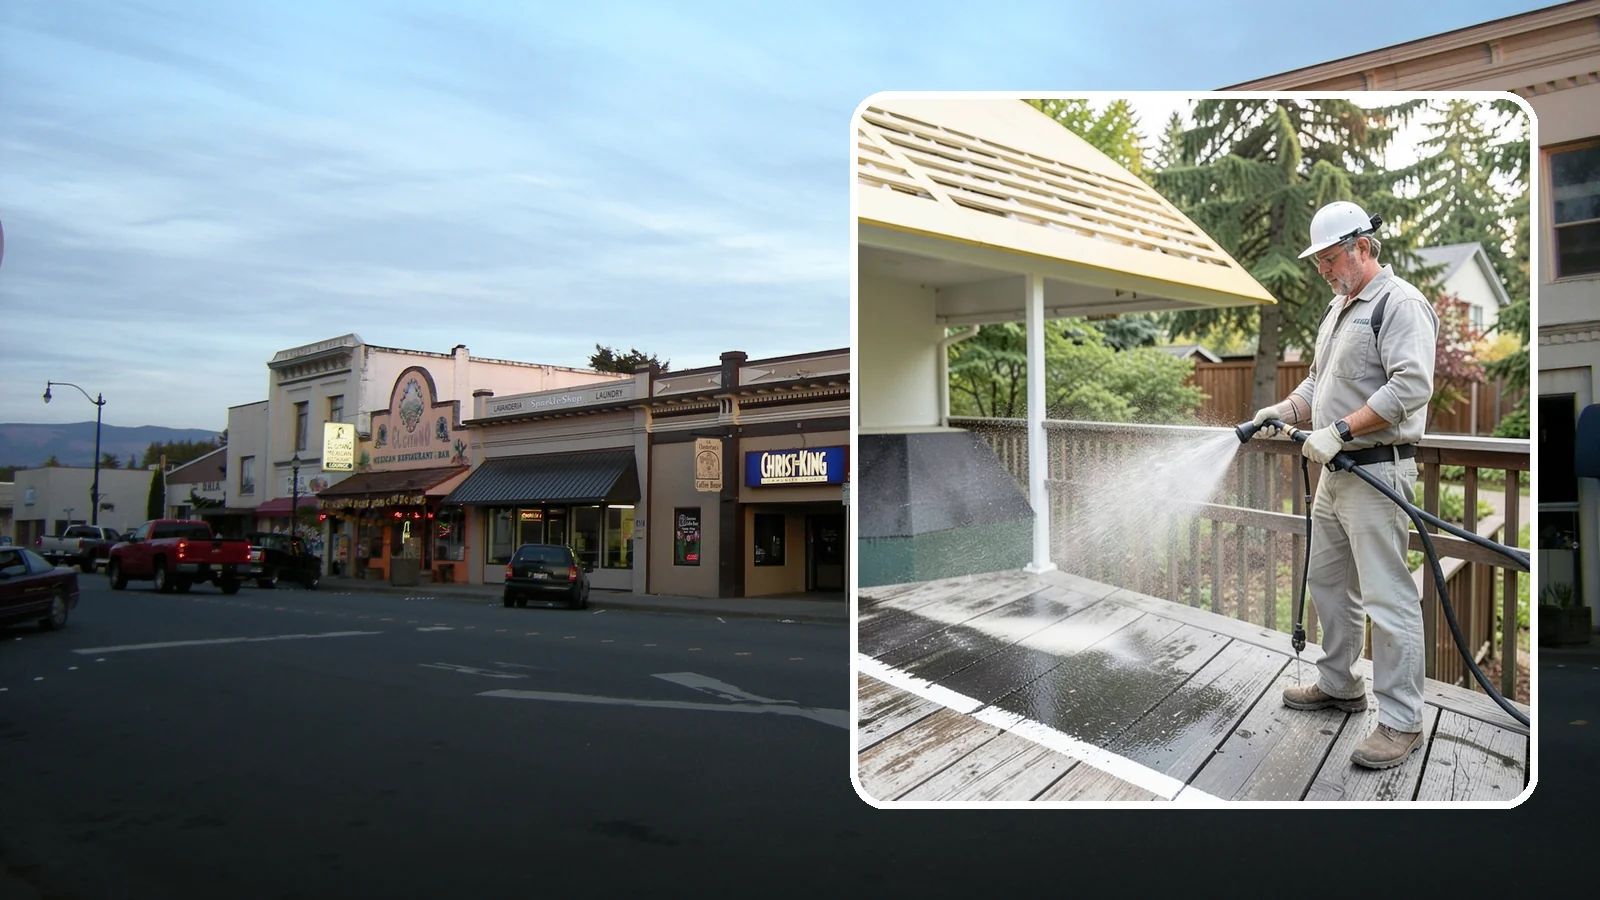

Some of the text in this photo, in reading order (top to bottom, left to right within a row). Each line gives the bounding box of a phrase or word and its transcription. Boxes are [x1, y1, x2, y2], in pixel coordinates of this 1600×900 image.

[595, 389, 624, 400] LAUNDRY
[493, 402, 523, 412] LAVANDERIA
[530, 394, 582, 409] Sparkle Shop
[373, 454, 396, 464] MEXICAN
[398, 451, 433, 462] RESTAURANT
[438, 450, 450, 459] BAR
[760, 450, 827, 478] CHRIST KING
[696, 481, 722, 489] Coffee House
